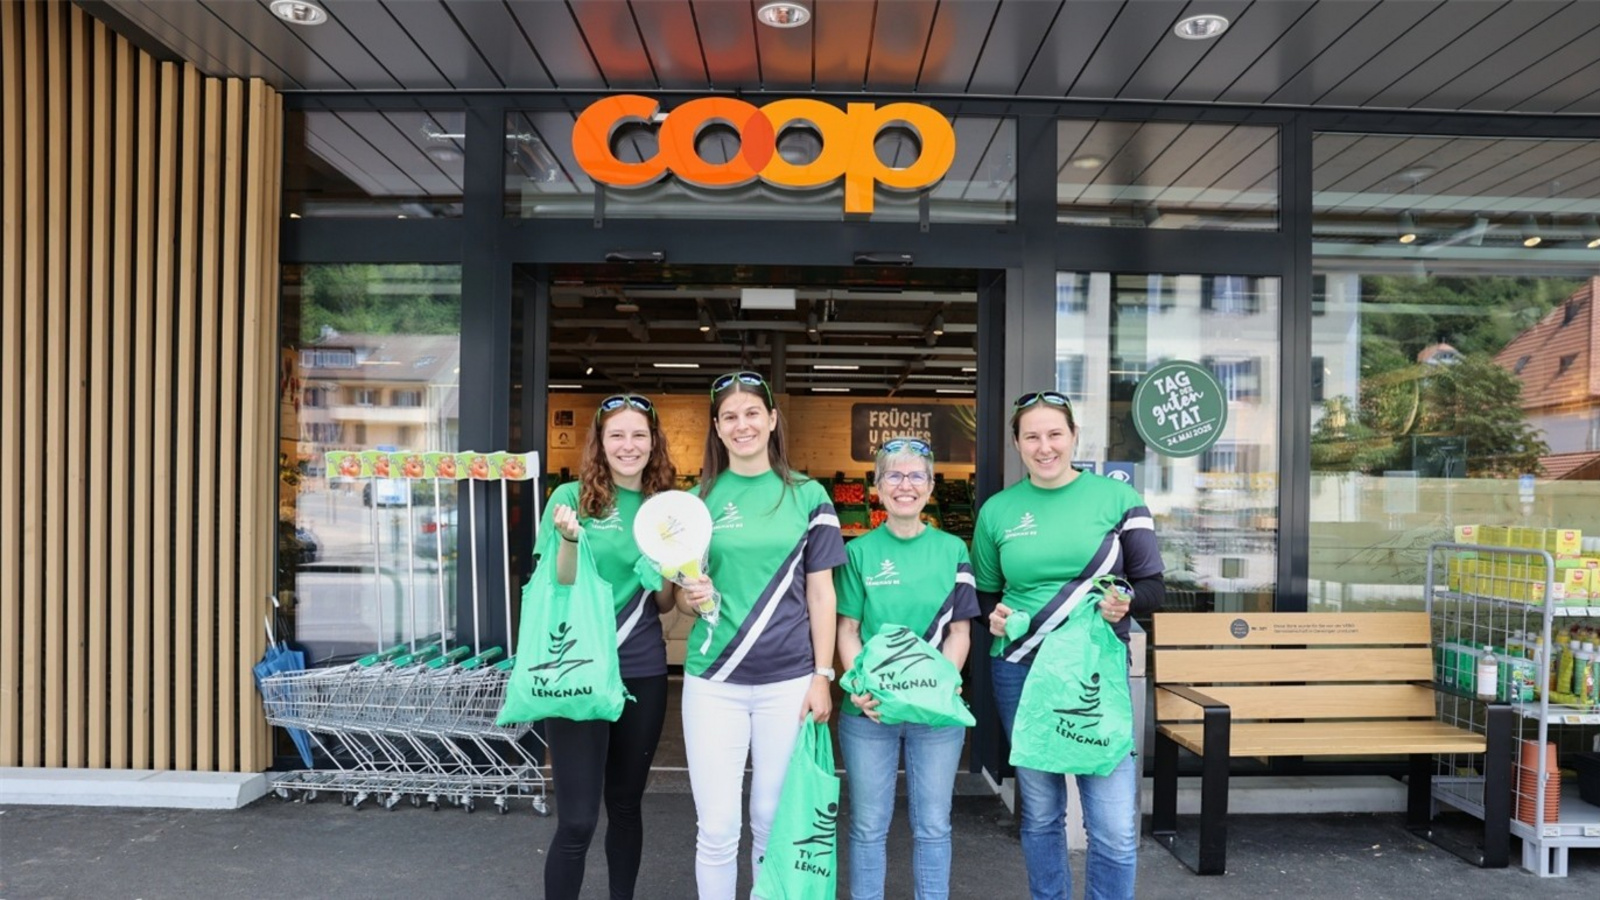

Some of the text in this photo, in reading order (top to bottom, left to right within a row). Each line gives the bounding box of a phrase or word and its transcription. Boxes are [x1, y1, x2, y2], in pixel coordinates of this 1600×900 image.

[572, 94, 956, 213] coop
[1154, 371, 1190, 395] TAG
[1179, 386, 1193, 395] DER
[1152, 391, 1203, 426] guten
[869, 408, 932, 429] FRÜCHT
[1168, 406, 1201, 431] TAT
[869, 430, 879, 443] U
[1178, 432, 1193, 442] MAI
[533, 676, 549, 687] TV
[879, 671, 896, 683] TV
[878, 678, 938, 691] LENGNAU
[531, 686, 593, 698] LENGNAU
[1059, 717, 1076, 729] TV
[1055, 725, 1110, 747] LENGNAU
[799, 849, 813, 859] TV
